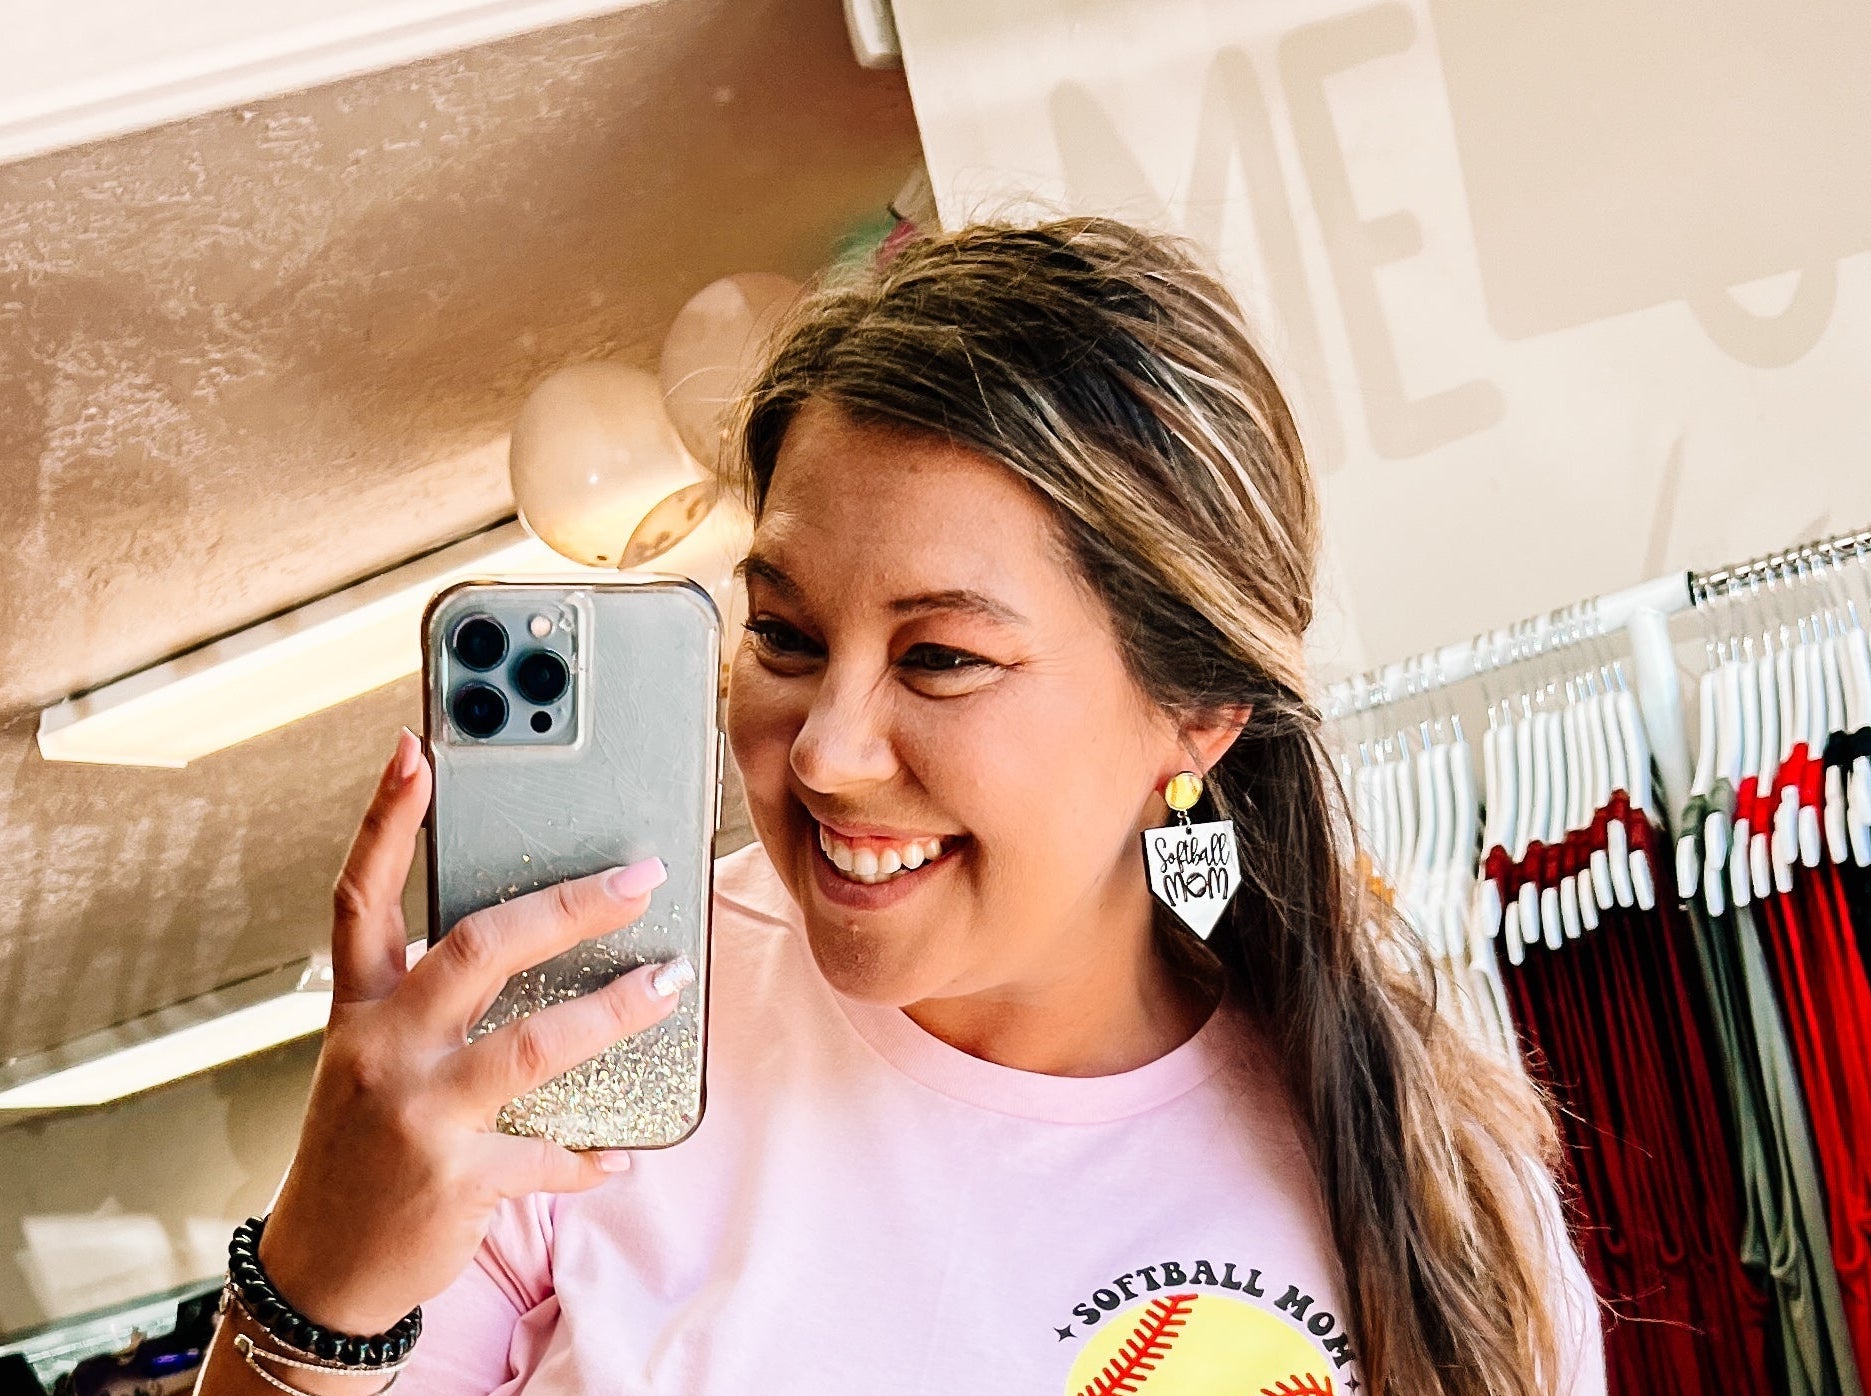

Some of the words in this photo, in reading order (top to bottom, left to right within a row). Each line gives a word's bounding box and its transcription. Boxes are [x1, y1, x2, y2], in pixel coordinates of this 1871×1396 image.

[1155, 833, 1230, 873] Softball
[1072, 1260, 1264, 1325] SOFTBALL
[1274, 1285, 1356, 1369] MOM
